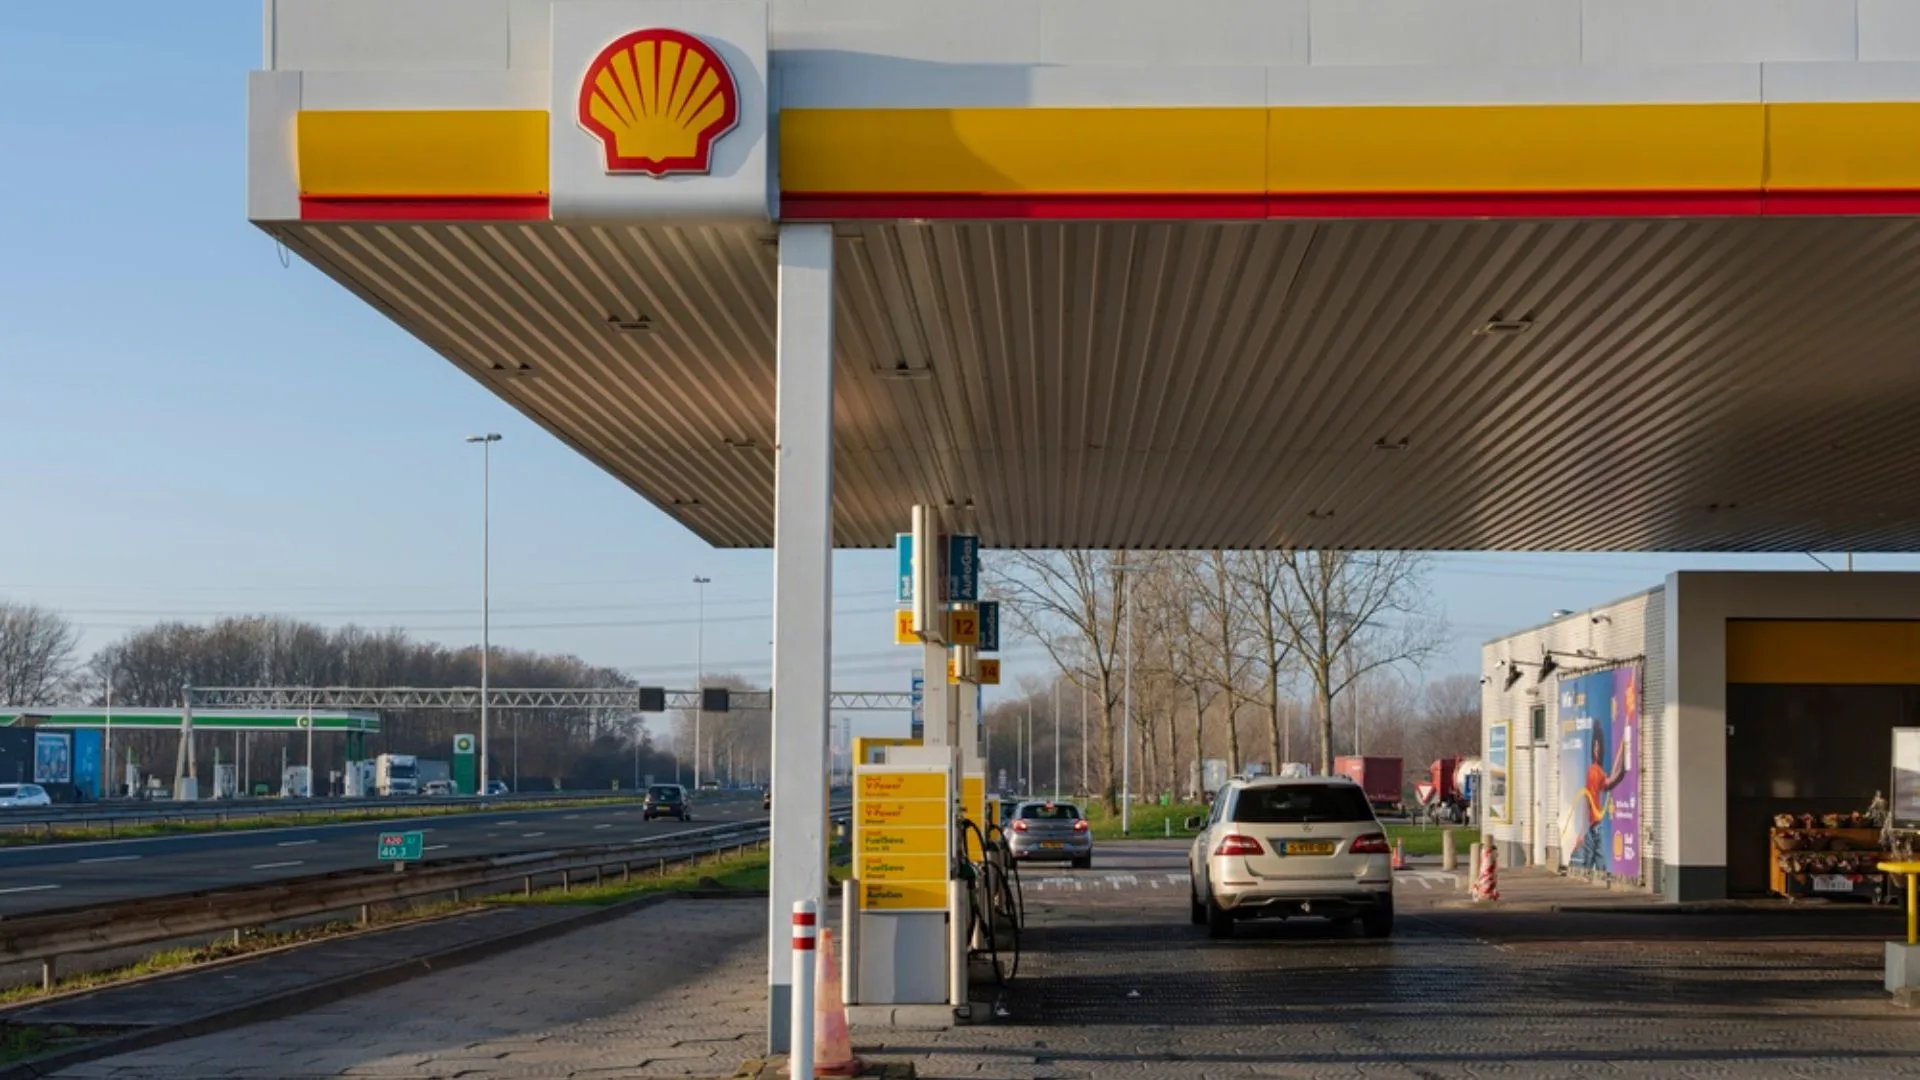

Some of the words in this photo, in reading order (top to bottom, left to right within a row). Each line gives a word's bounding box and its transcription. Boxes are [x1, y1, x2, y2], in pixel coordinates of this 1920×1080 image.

[961, 539, 973, 598] AutoGas
[955, 618, 974, 636] 12
[981, 665, 996, 677] 14
